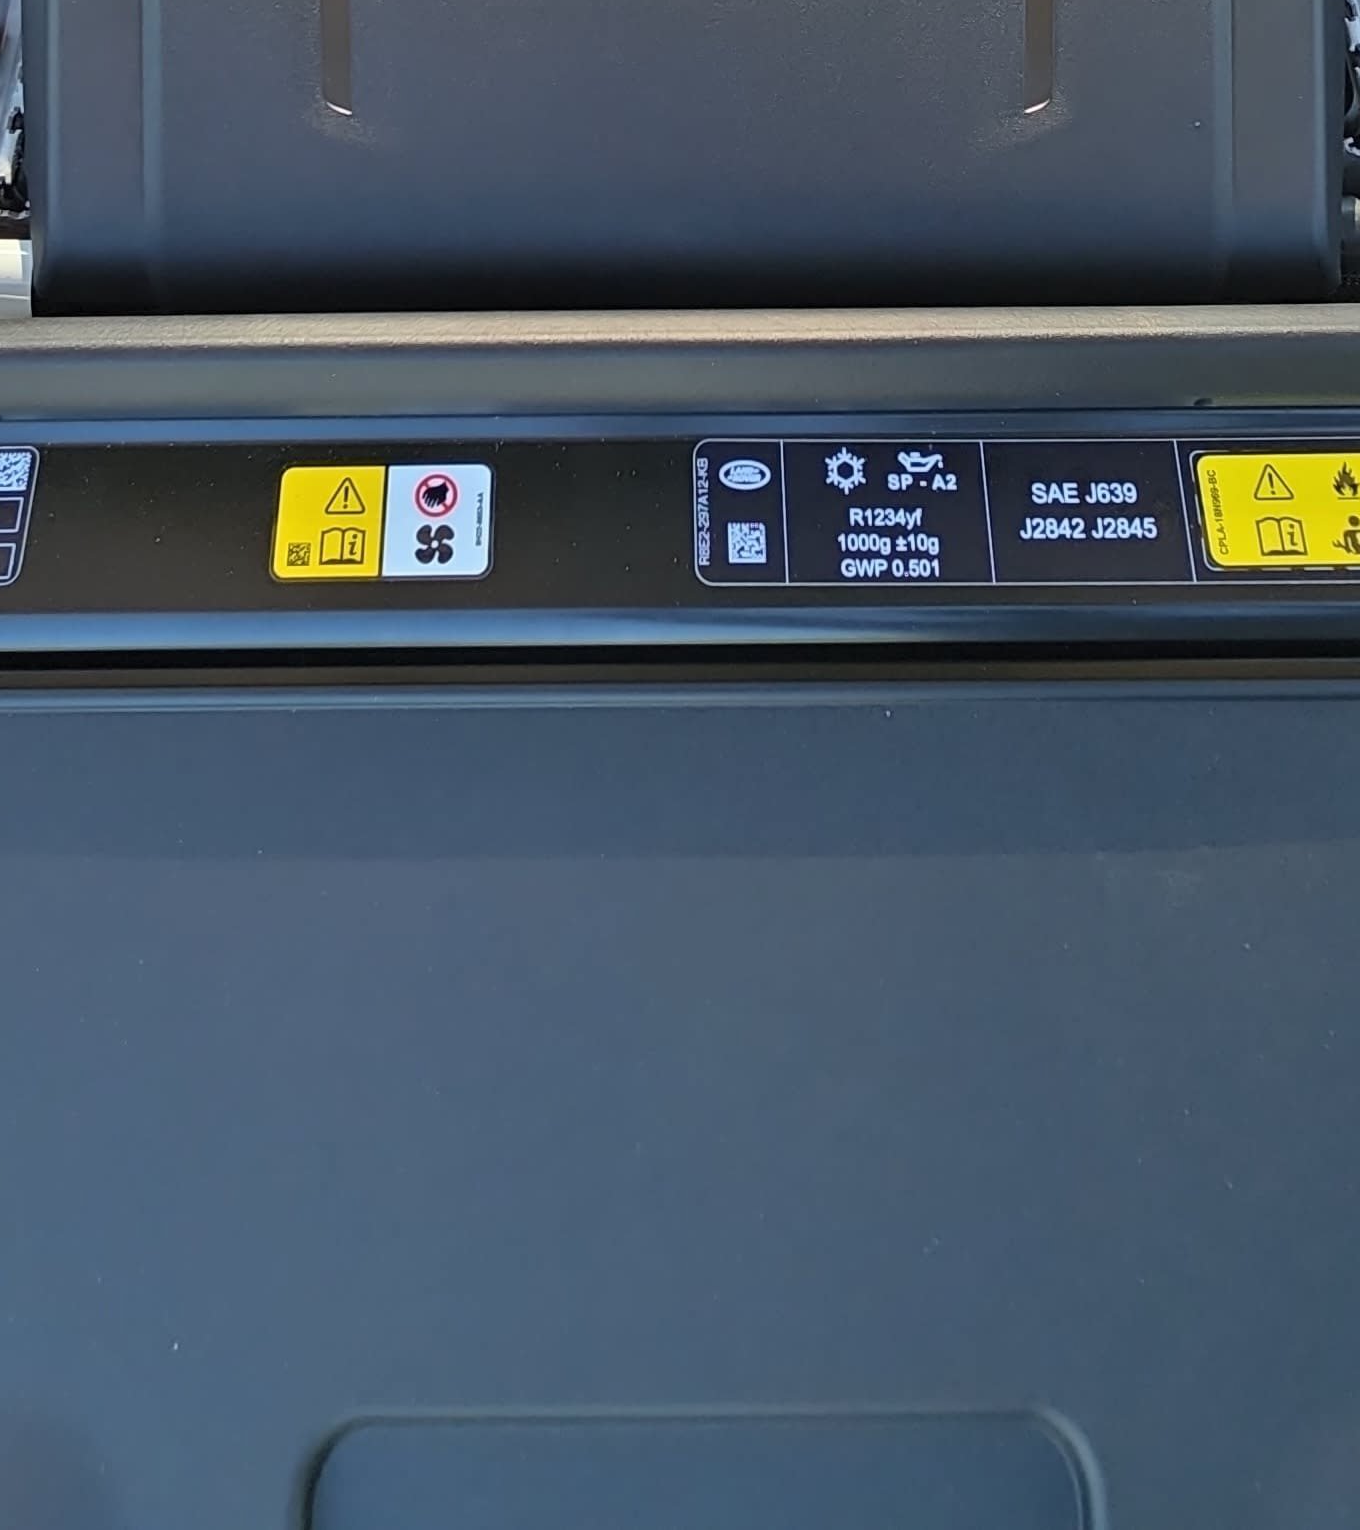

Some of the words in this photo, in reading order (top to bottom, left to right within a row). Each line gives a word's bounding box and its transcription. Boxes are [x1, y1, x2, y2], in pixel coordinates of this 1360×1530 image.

[887, 473, 913, 490] SP
[932, 473, 957, 490] A2
[1031, 482, 1080, 504] SAE
[1084, 482, 1137, 504] J639
[849, 507, 923, 530] R1234yf
[1020, 517, 1086, 539] J2842
[1091, 516, 1158, 539] J2845
[837, 533, 891, 556] 1000g
[895, 533, 940, 556] ±10g
[840, 558, 888, 578] GWP
[891, 558, 940, 578] 0.501
